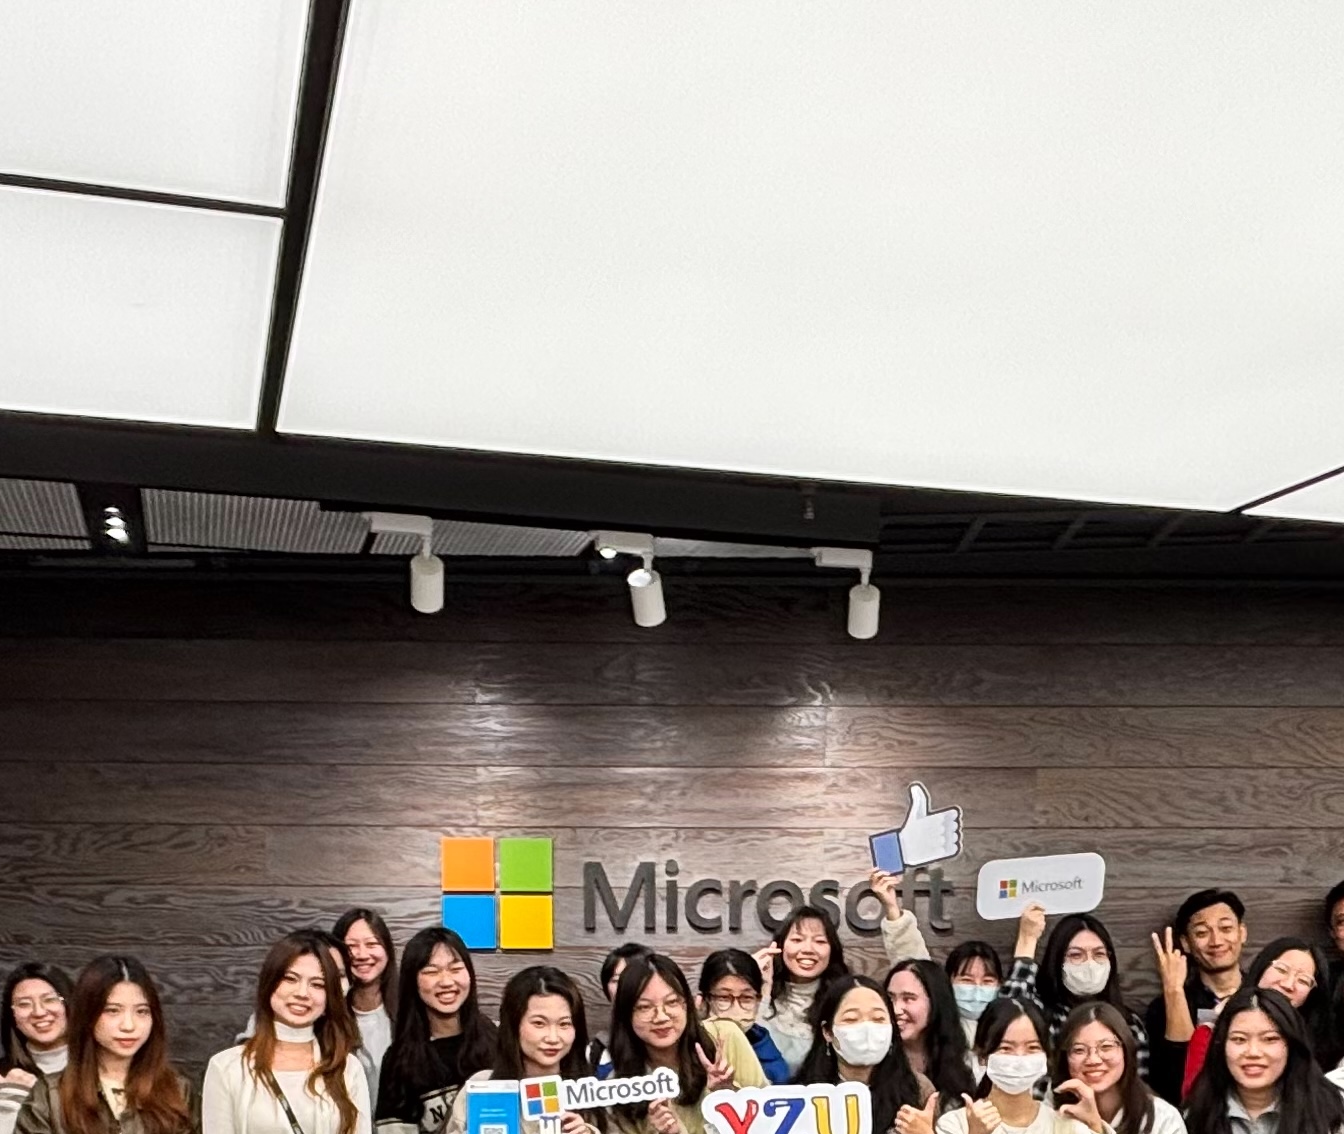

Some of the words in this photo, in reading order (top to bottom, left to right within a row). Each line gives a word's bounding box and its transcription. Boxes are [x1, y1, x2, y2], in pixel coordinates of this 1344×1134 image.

[582, 858, 954, 935] Microsoft
[1021, 876, 1084, 895] Microsoft
[565, 1072, 675, 1105] Microsoft
